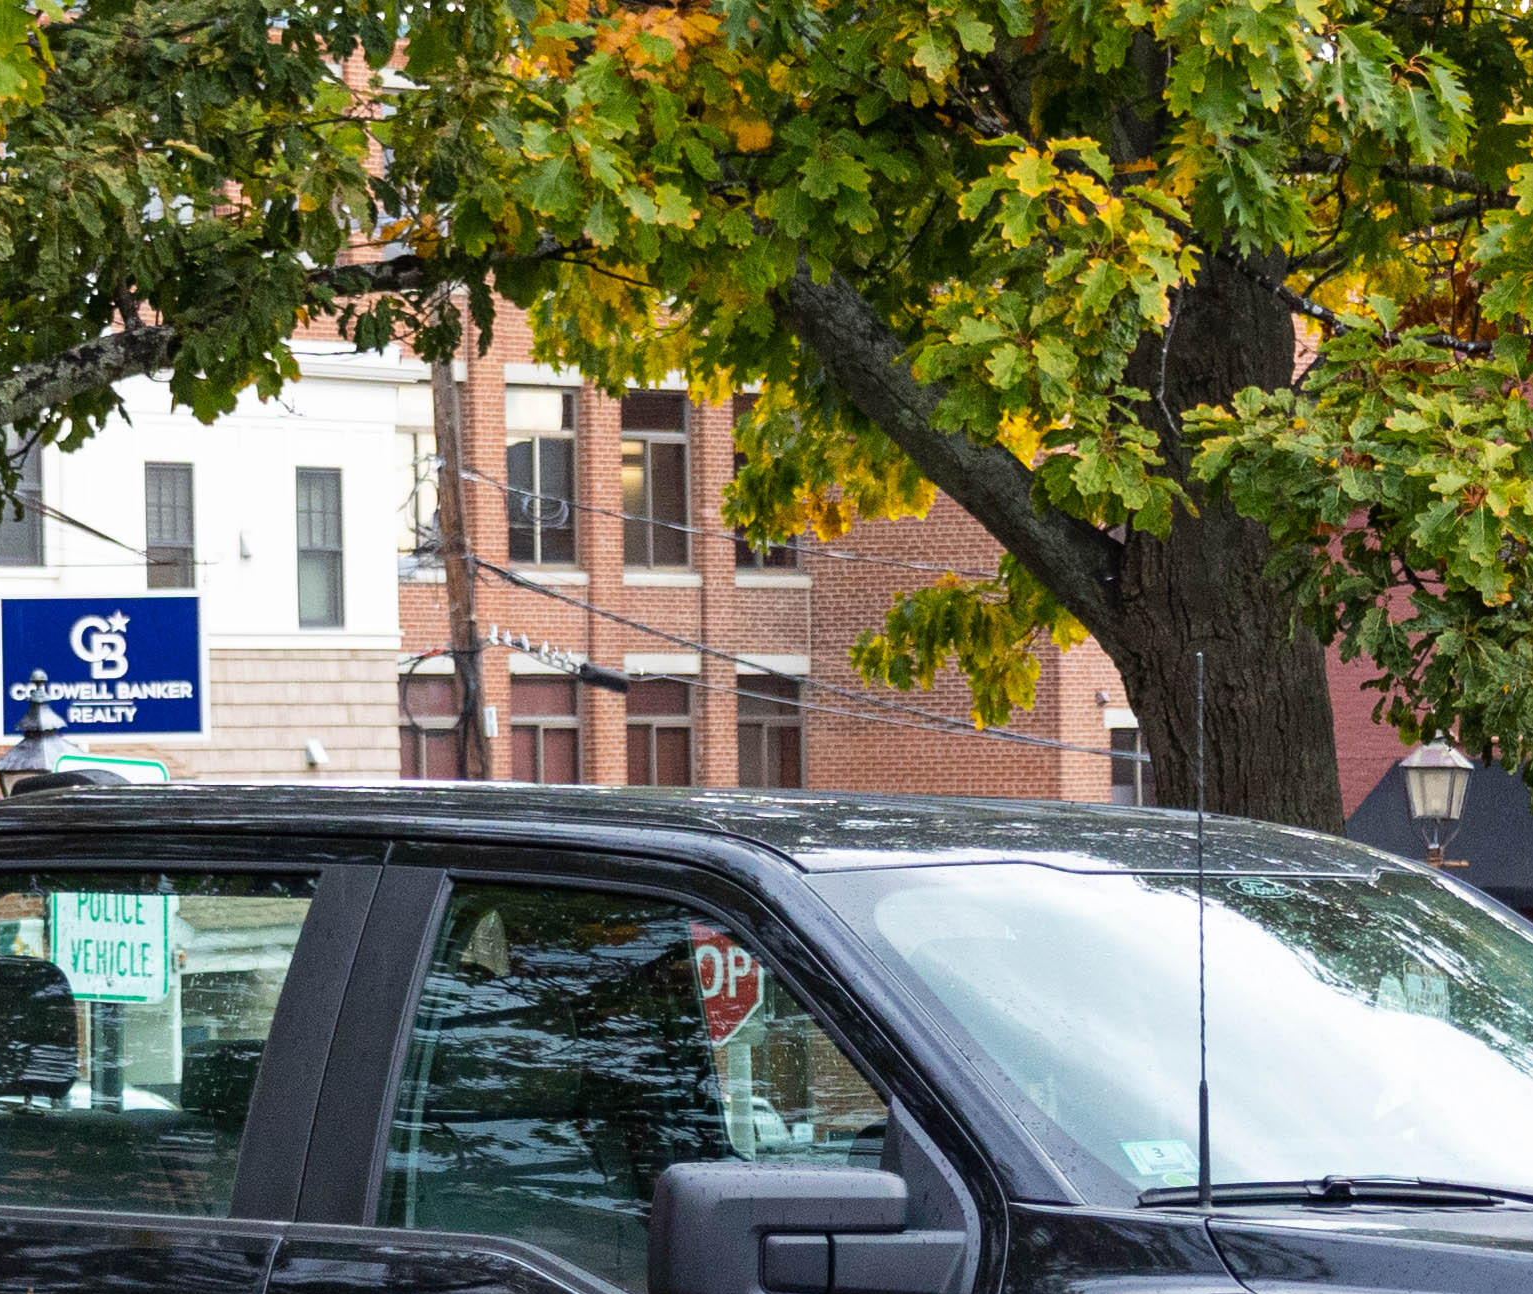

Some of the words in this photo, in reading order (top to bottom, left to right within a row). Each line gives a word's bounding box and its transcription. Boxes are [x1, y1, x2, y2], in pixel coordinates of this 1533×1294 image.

[116, 681, 193, 699] BANKER
[69, 706, 137, 723] REALTY
[78, 892, 145, 925] POLICE
[71, 938, 153, 978] VEHICLE
[695, 944, 752, 998] OP
